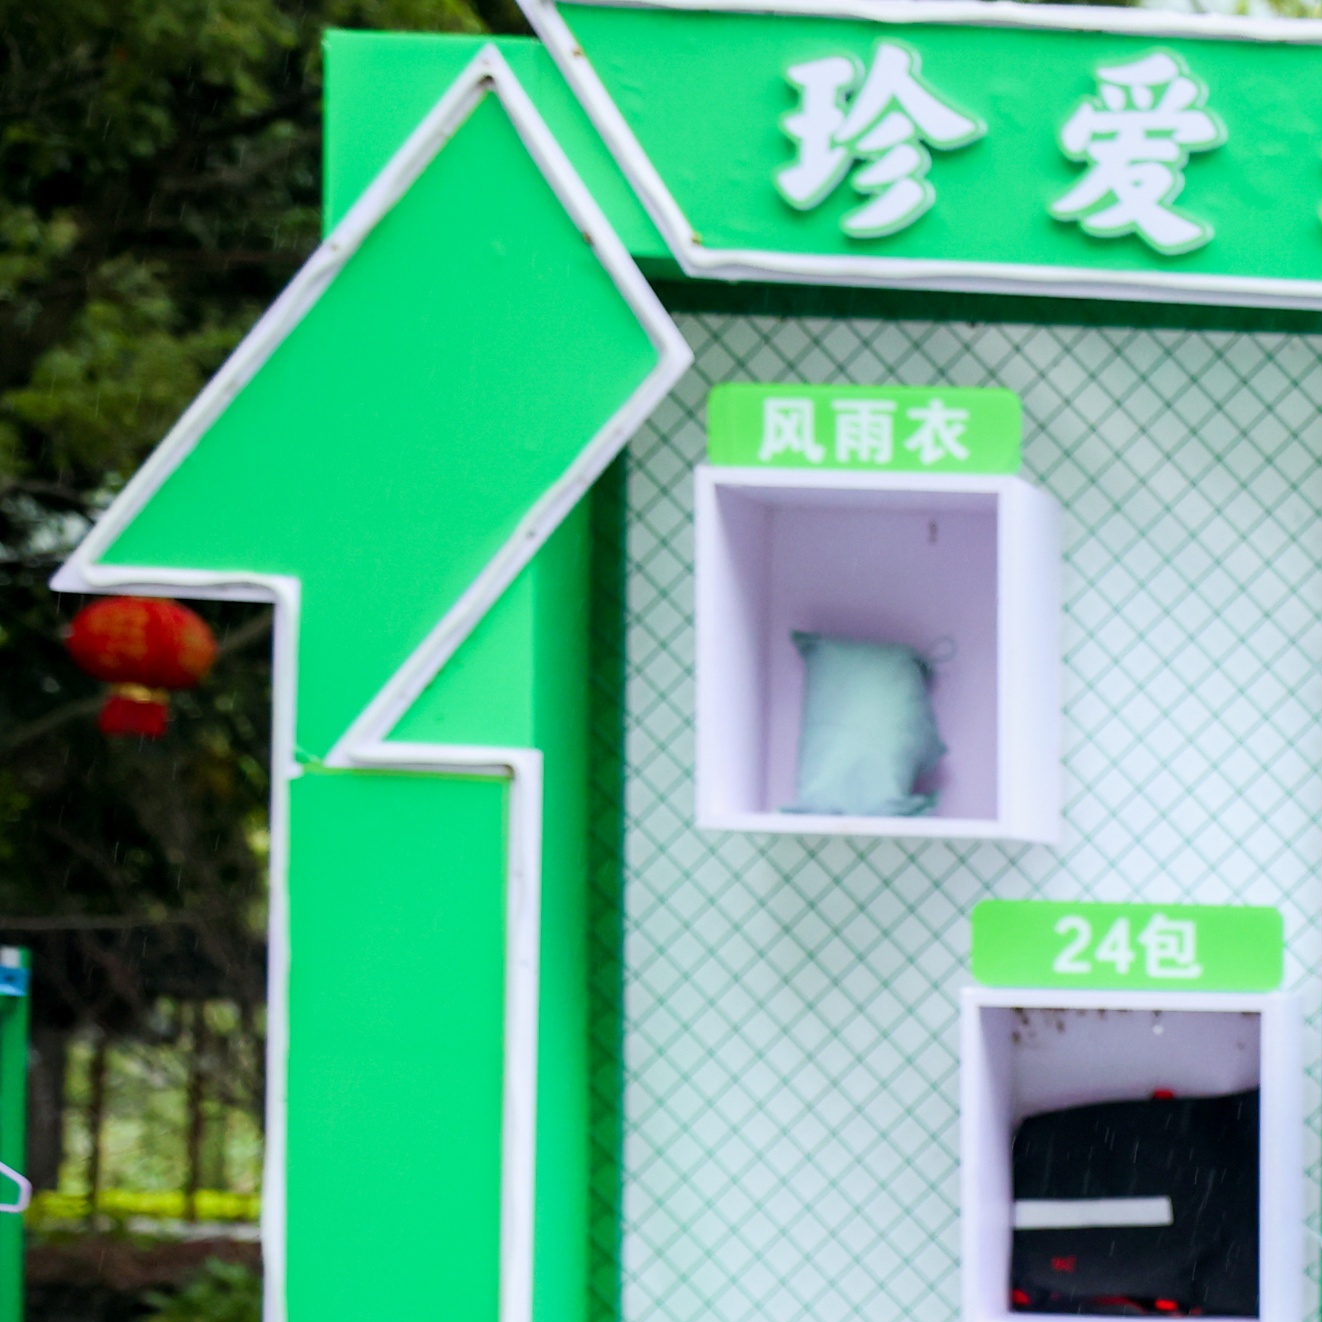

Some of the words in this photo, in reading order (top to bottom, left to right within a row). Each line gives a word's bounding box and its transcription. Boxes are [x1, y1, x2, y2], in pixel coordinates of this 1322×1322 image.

[757, 396, 971, 466] 风雨衣
[1052, 914, 1203, 979] 24包
